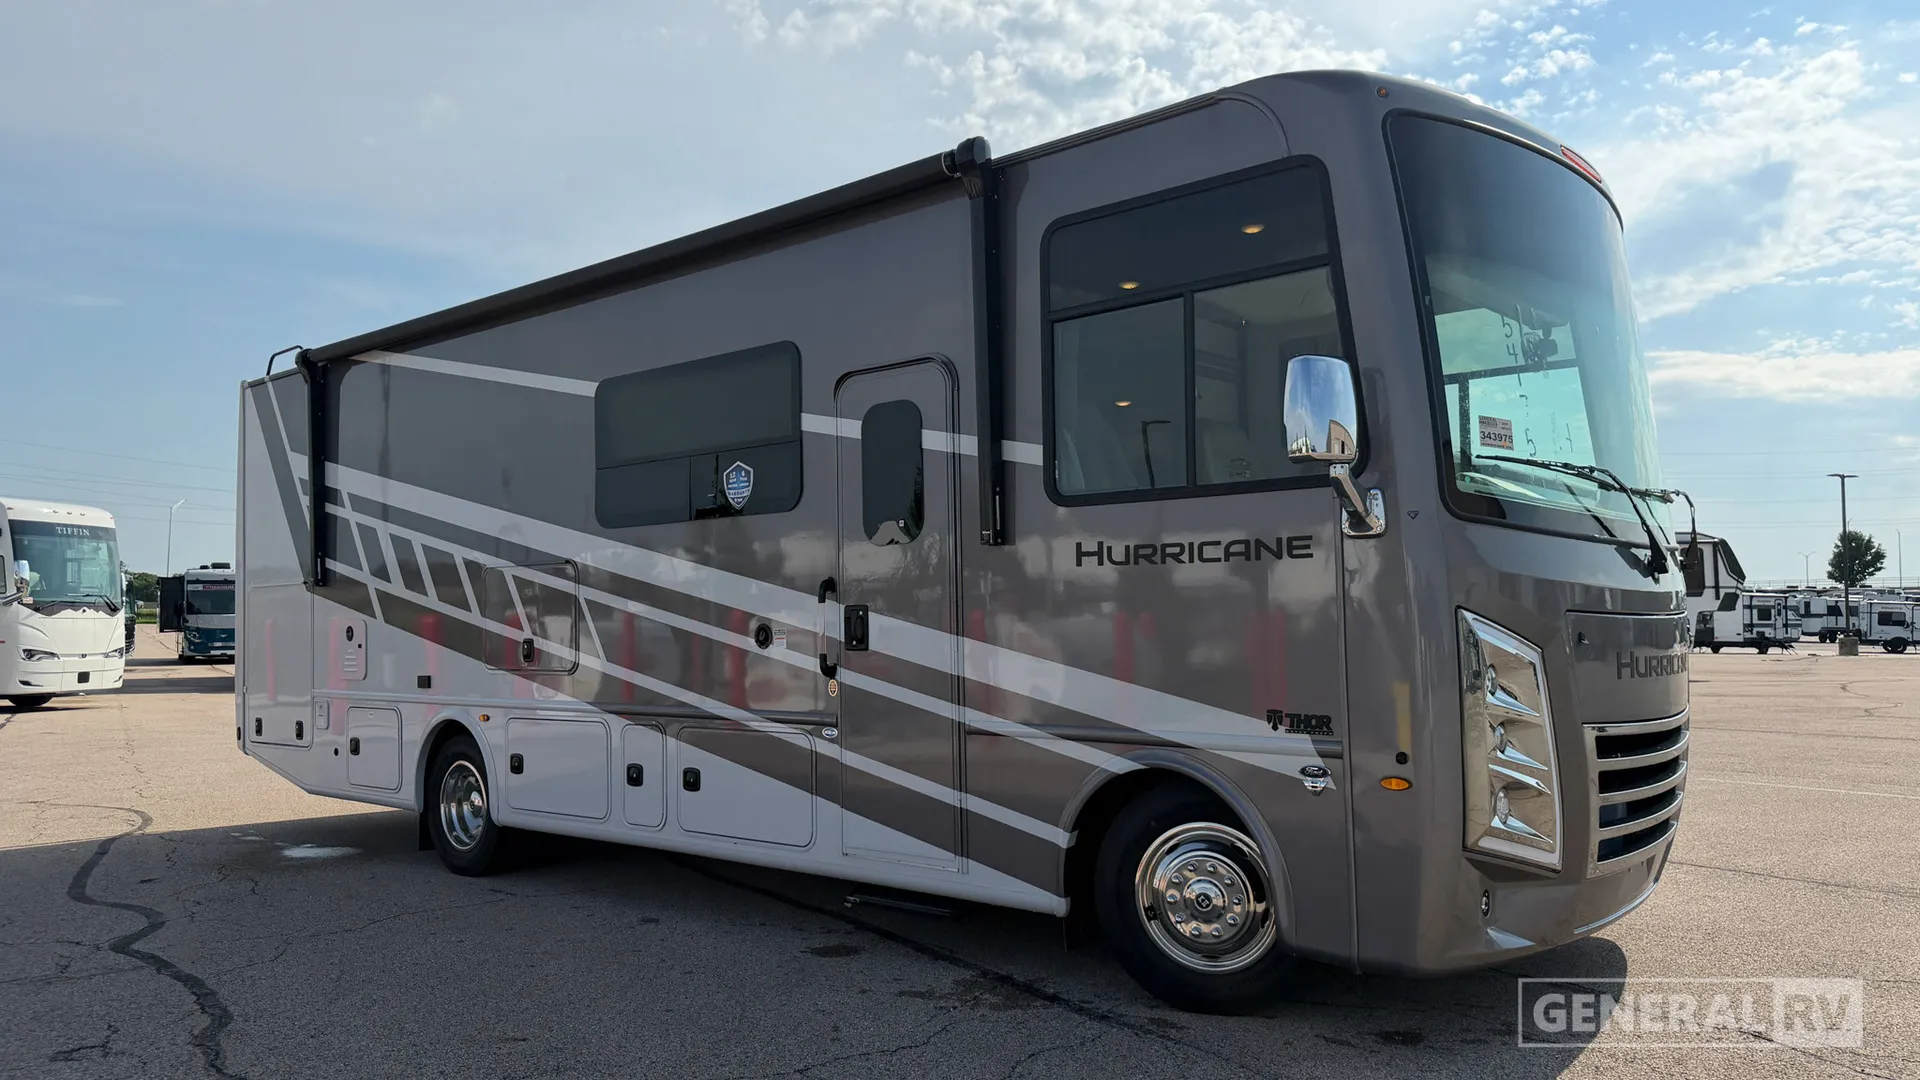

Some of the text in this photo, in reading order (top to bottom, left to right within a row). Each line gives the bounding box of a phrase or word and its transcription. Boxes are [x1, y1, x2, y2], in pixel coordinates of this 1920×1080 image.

[1480, 431, 1513, 443] 343975
[56, 526, 90, 536] TIFFIN
[1075, 535, 1314, 567] HURRICANE
[1285, 714, 1333, 731] THOR
